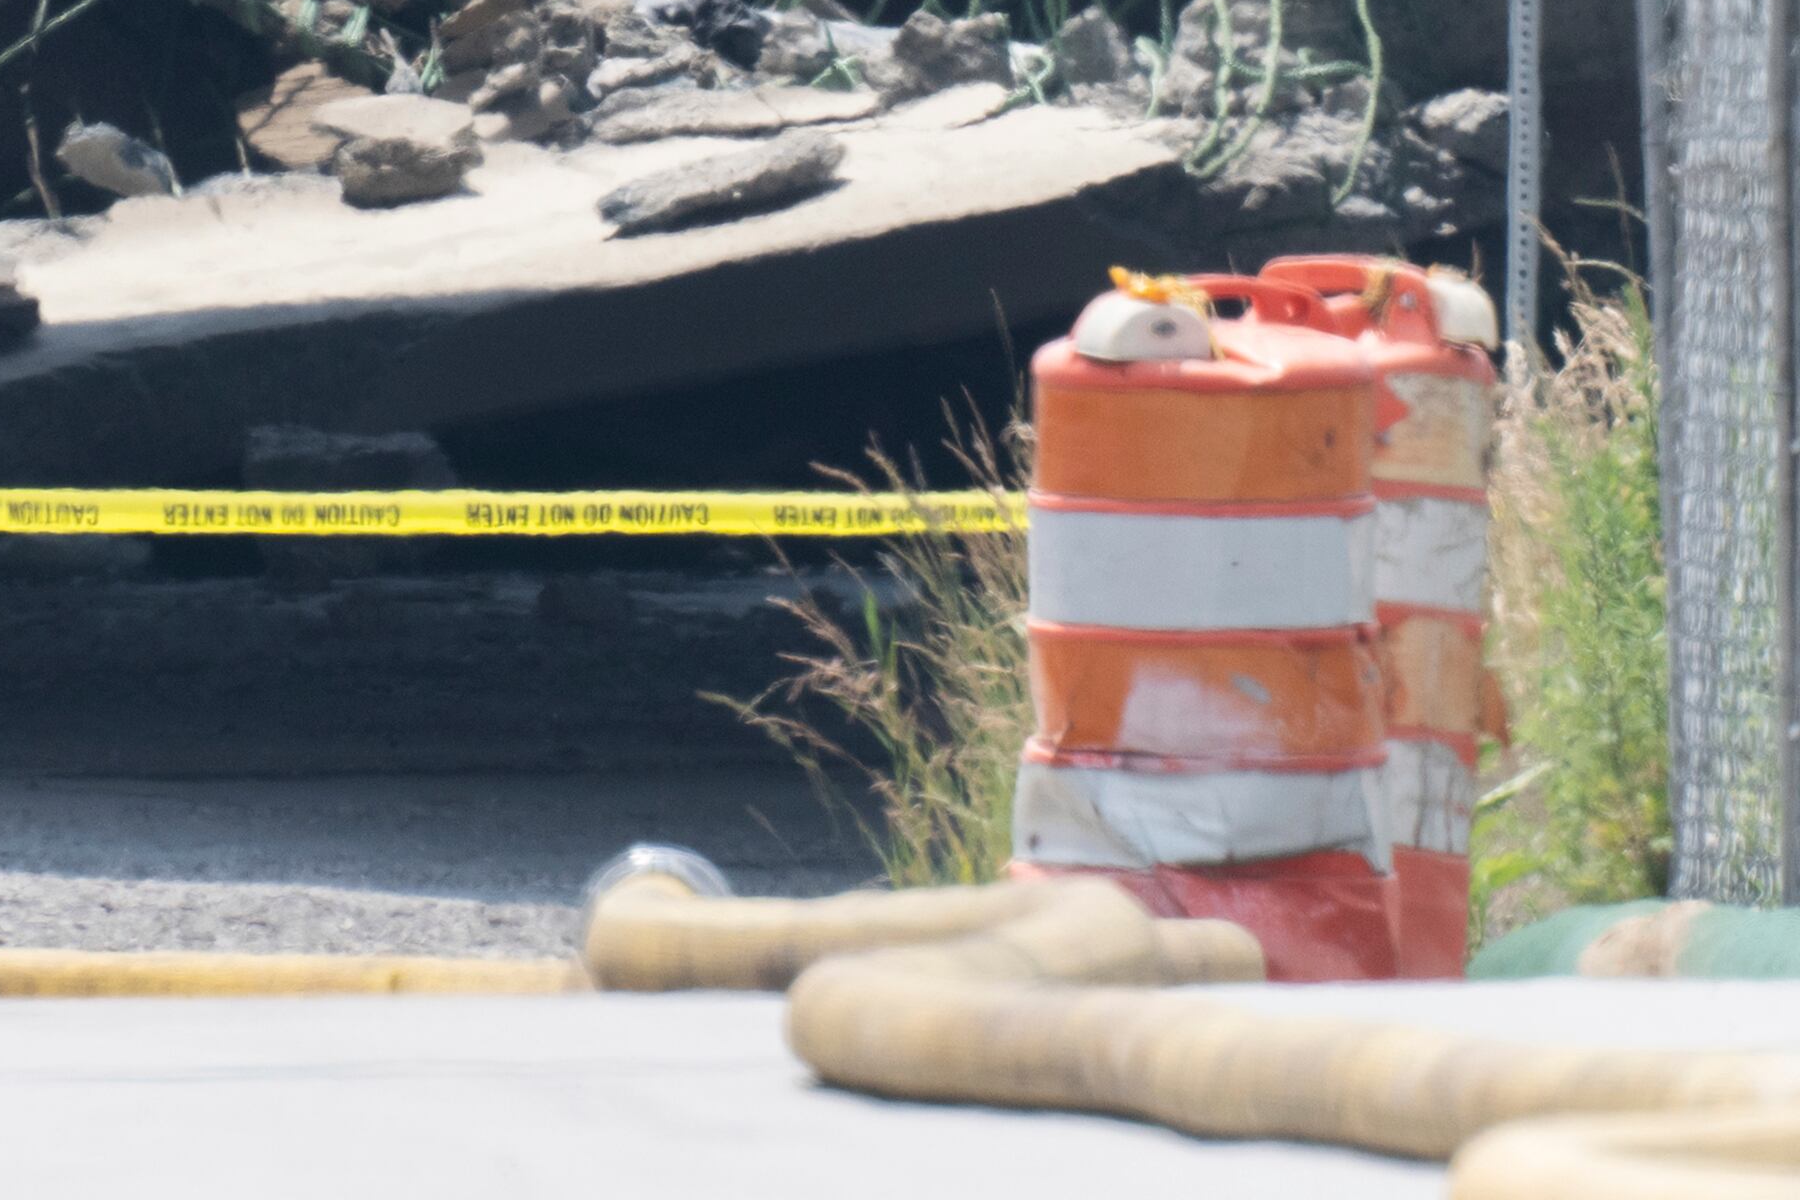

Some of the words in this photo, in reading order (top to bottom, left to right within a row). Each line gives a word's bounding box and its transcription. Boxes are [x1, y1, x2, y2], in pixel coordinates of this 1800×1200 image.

[8, 502, 99, 525] CAUTION
[163, 503, 228, 525] ENTER
[236, 504, 273, 525] NOT
[281, 504, 306, 525] DO
[314, 504, 400, 527] CAUTION
[466, 502, 529, 525] ENTER
[538, 503, 576, 525] NOT
[583, 504, 612, 524] DO
[618, 504, 709, 526] CAUTION
[773, 504, 837, 528] ENTER
